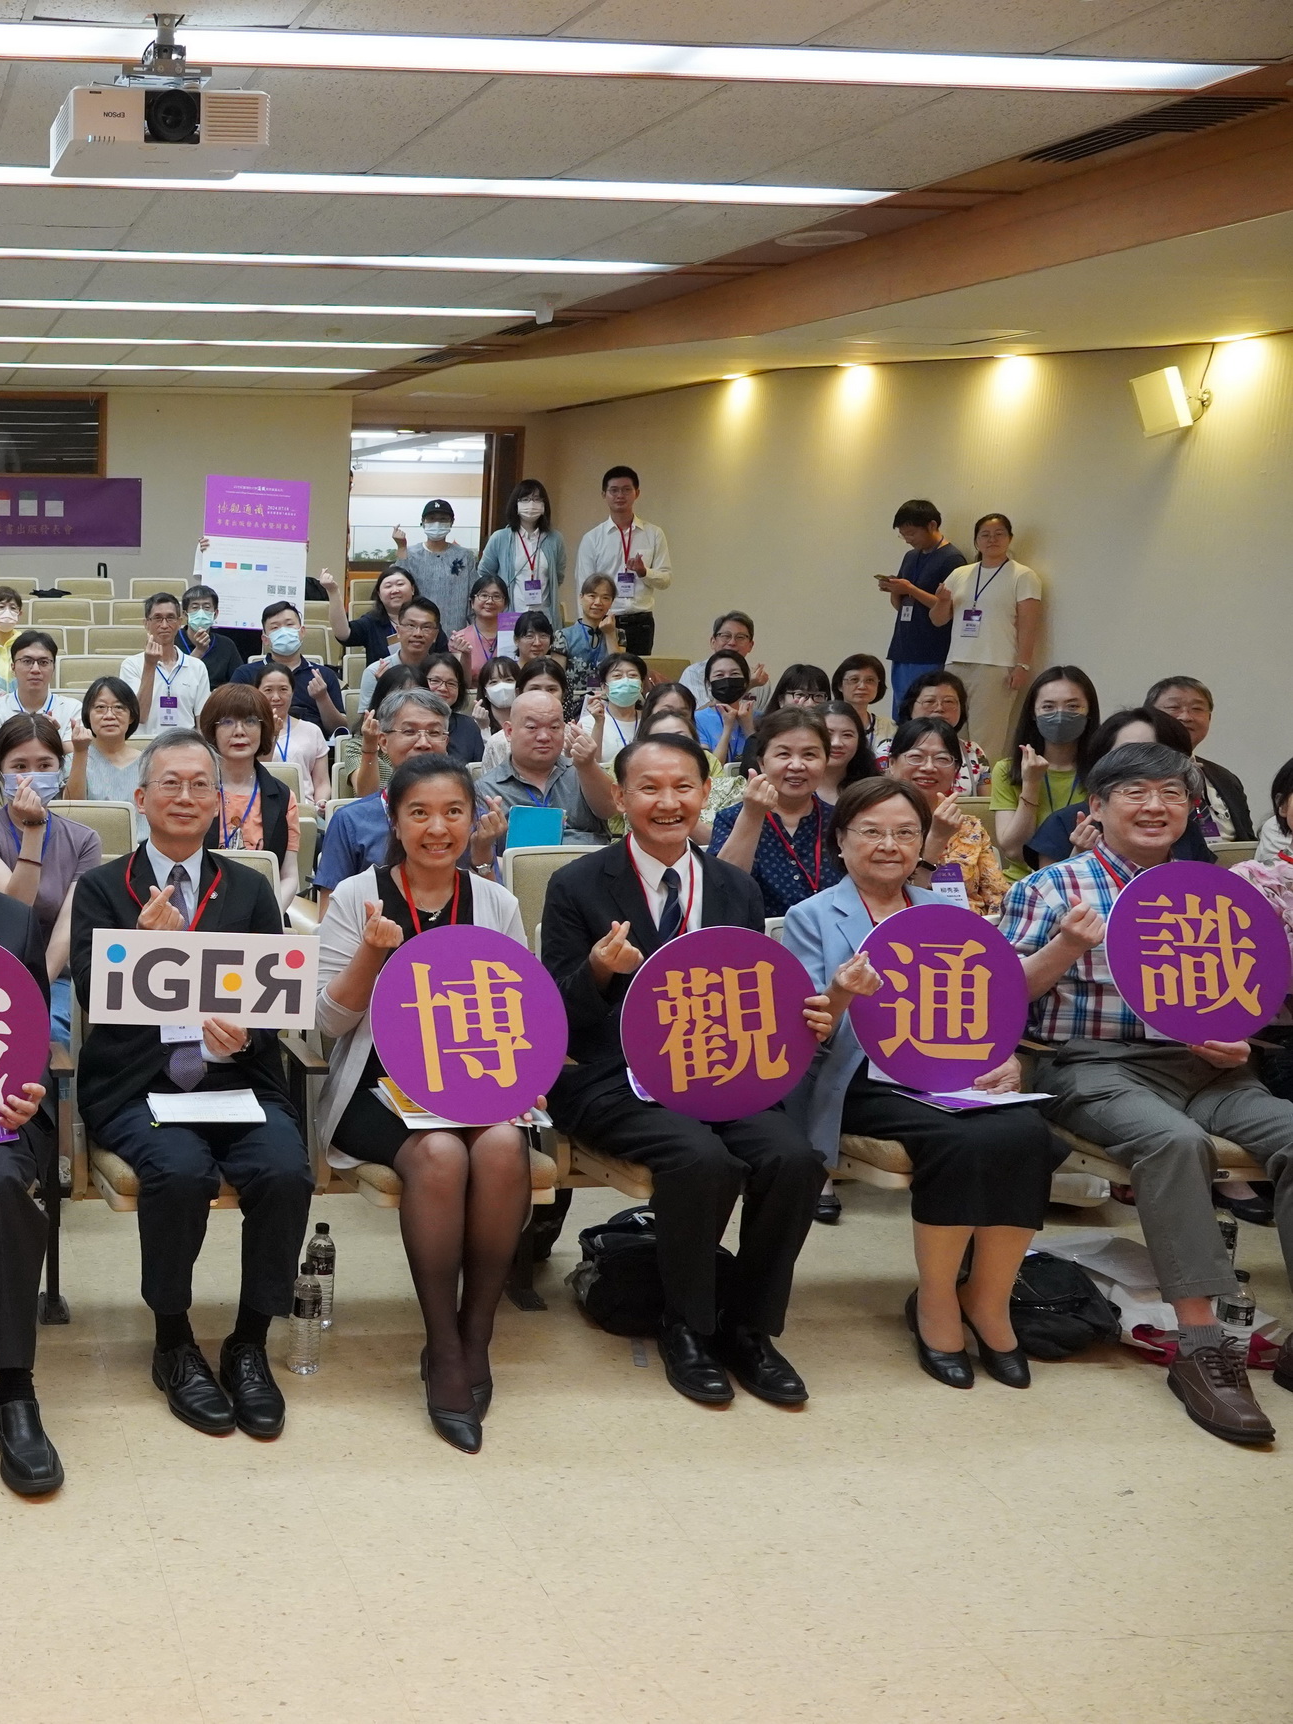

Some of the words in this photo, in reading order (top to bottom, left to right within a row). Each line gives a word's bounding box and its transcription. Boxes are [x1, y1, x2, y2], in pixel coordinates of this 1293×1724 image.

[878, 939, 995, 1060] 通
[1135, 894, 1262, 1017] 識
[401, 959, 533, 1093] 博
[652, 960, 790, 1093] 觀
